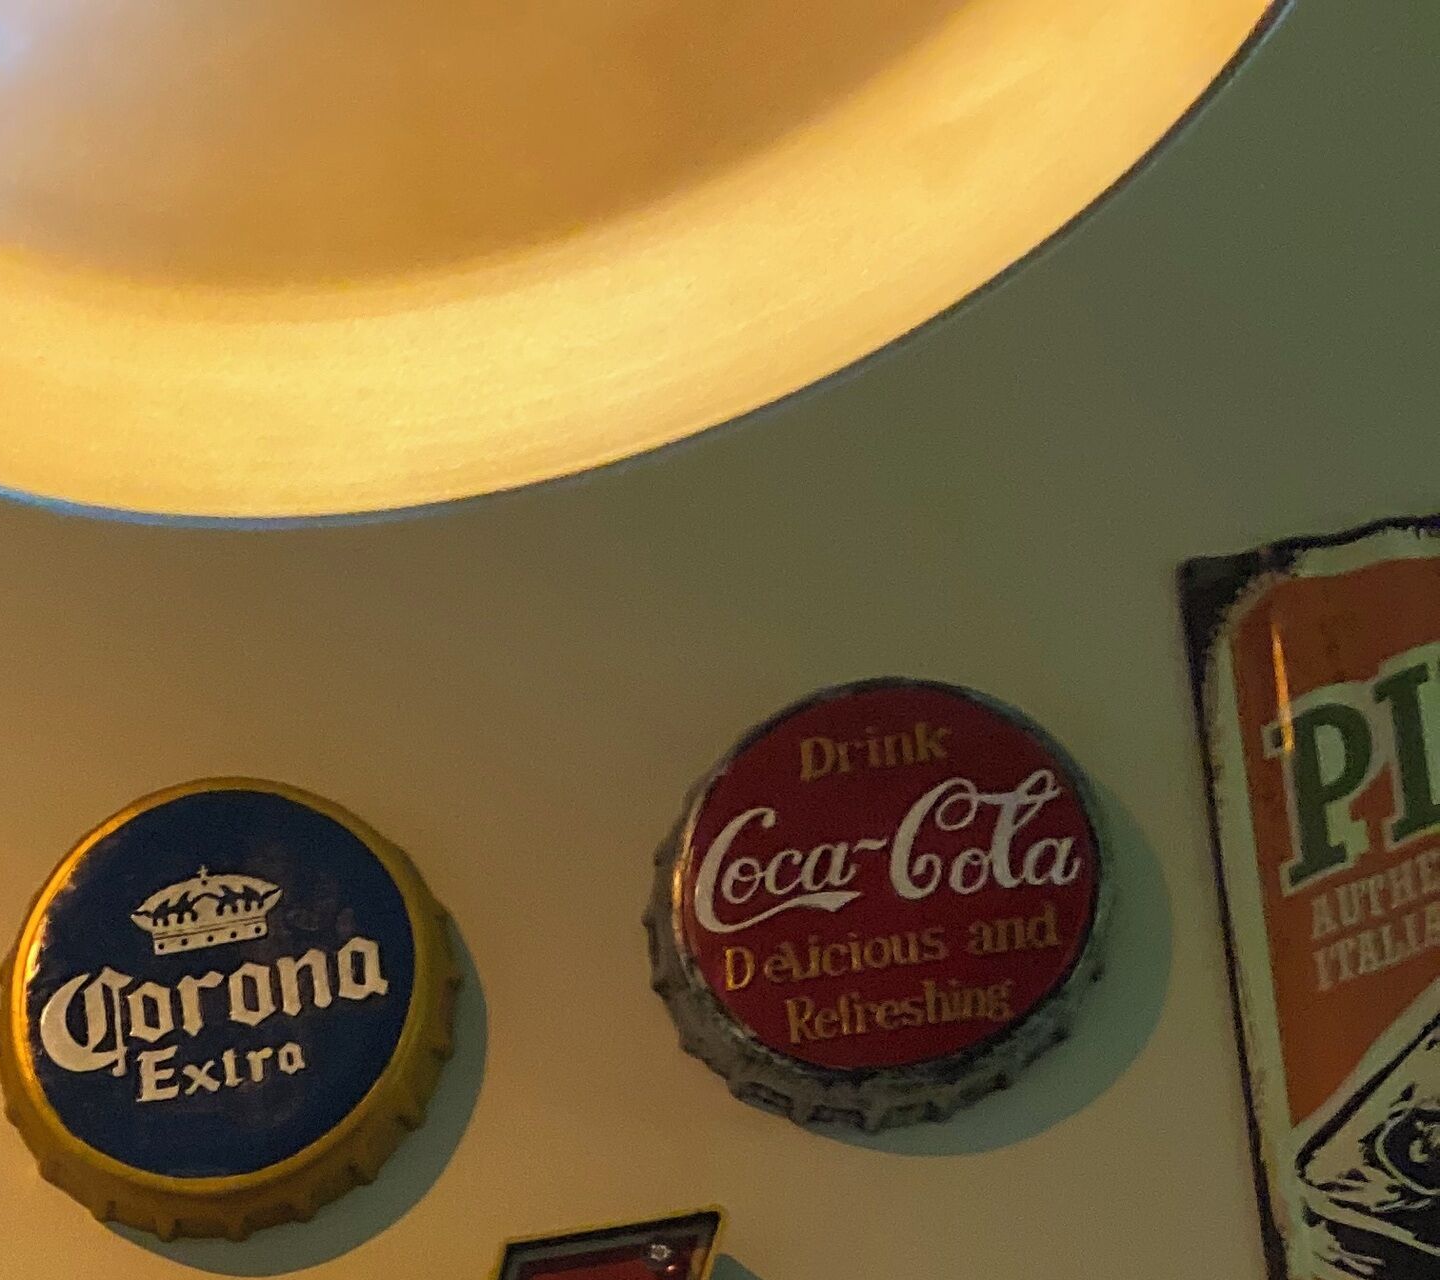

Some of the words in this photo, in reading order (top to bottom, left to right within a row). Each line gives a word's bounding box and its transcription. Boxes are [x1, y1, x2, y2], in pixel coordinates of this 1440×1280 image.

[800, 722, 952, 783] Drink
[1270, 658, 1440, 888] PI
[694, 769, 1085, 933] Coca-Cola
[969, 904, 1059, 954] and
[40, 935, 389, 1077] Corona
[786, 978, 1015, 1044] Refreshing
[136, 1041, 306, 1103] Extra
